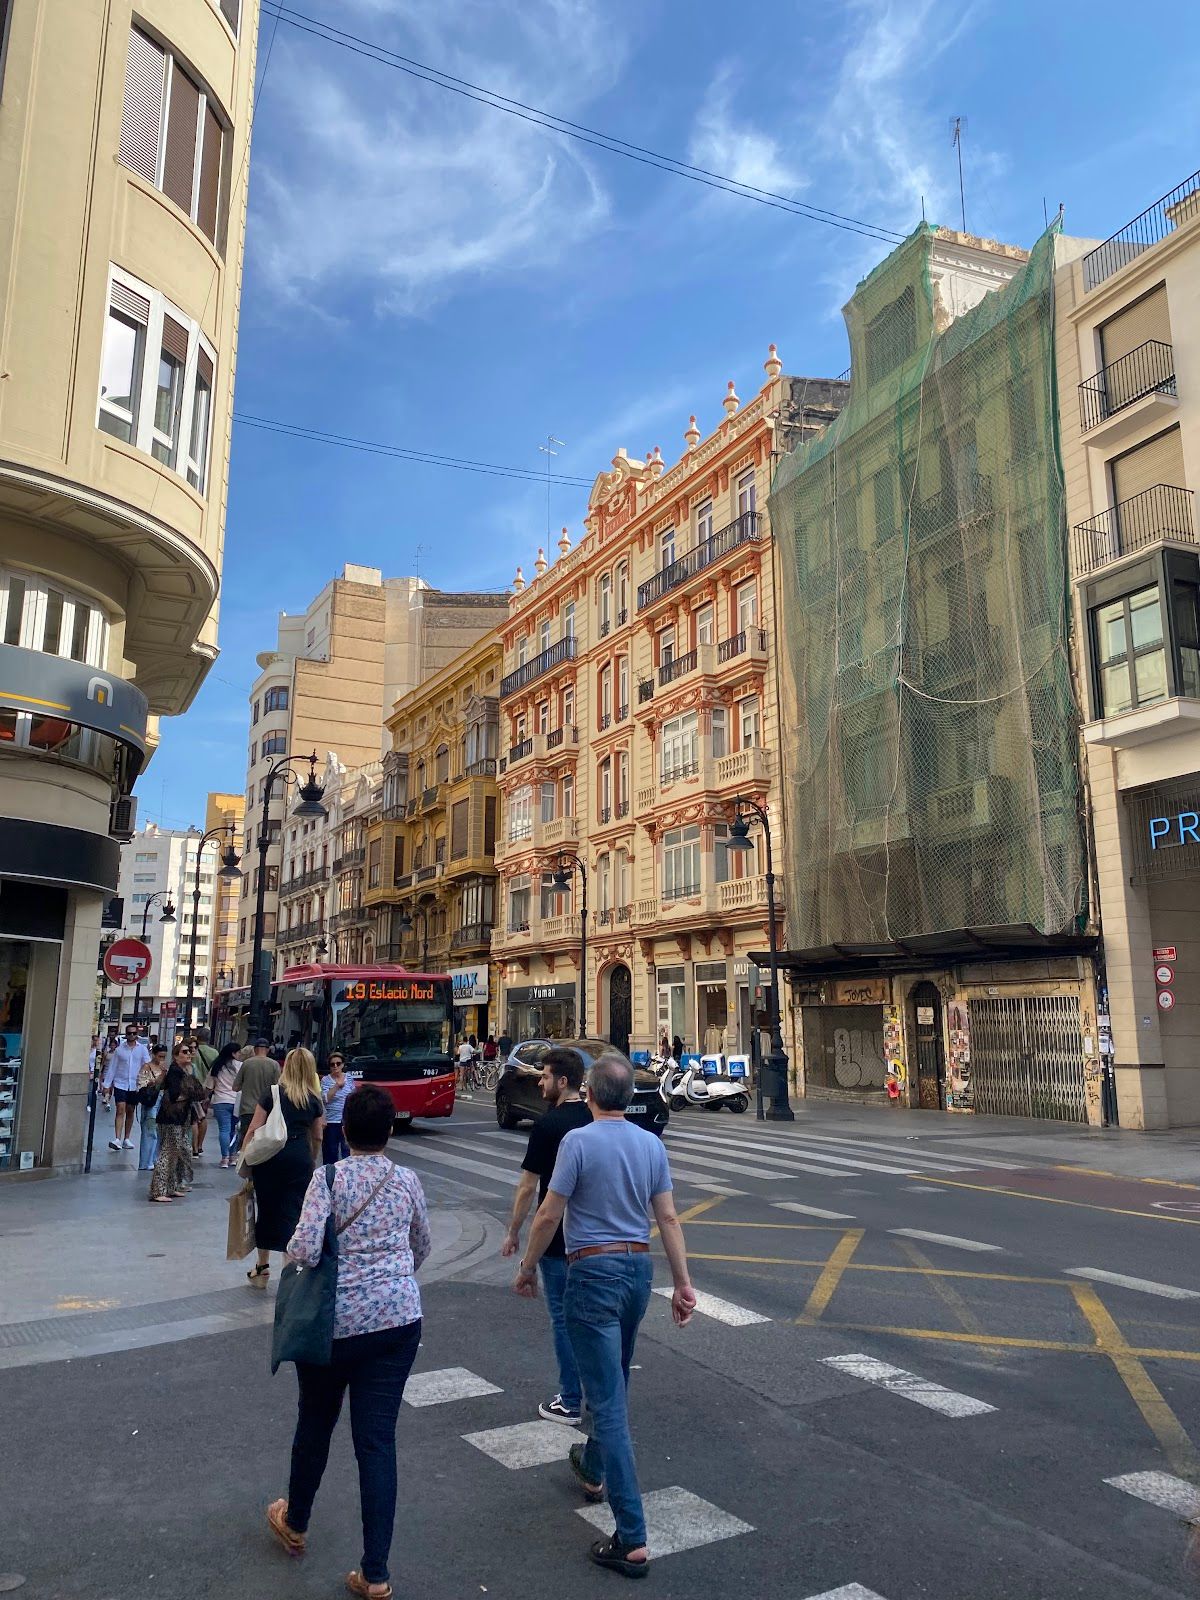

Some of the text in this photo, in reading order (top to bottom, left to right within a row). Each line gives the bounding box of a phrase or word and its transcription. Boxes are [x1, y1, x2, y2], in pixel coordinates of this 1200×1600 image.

[346, 983, 366, 999] 19
[411, 983, 434, 999] Nord
[533, 987, 556, 998] Yuman
